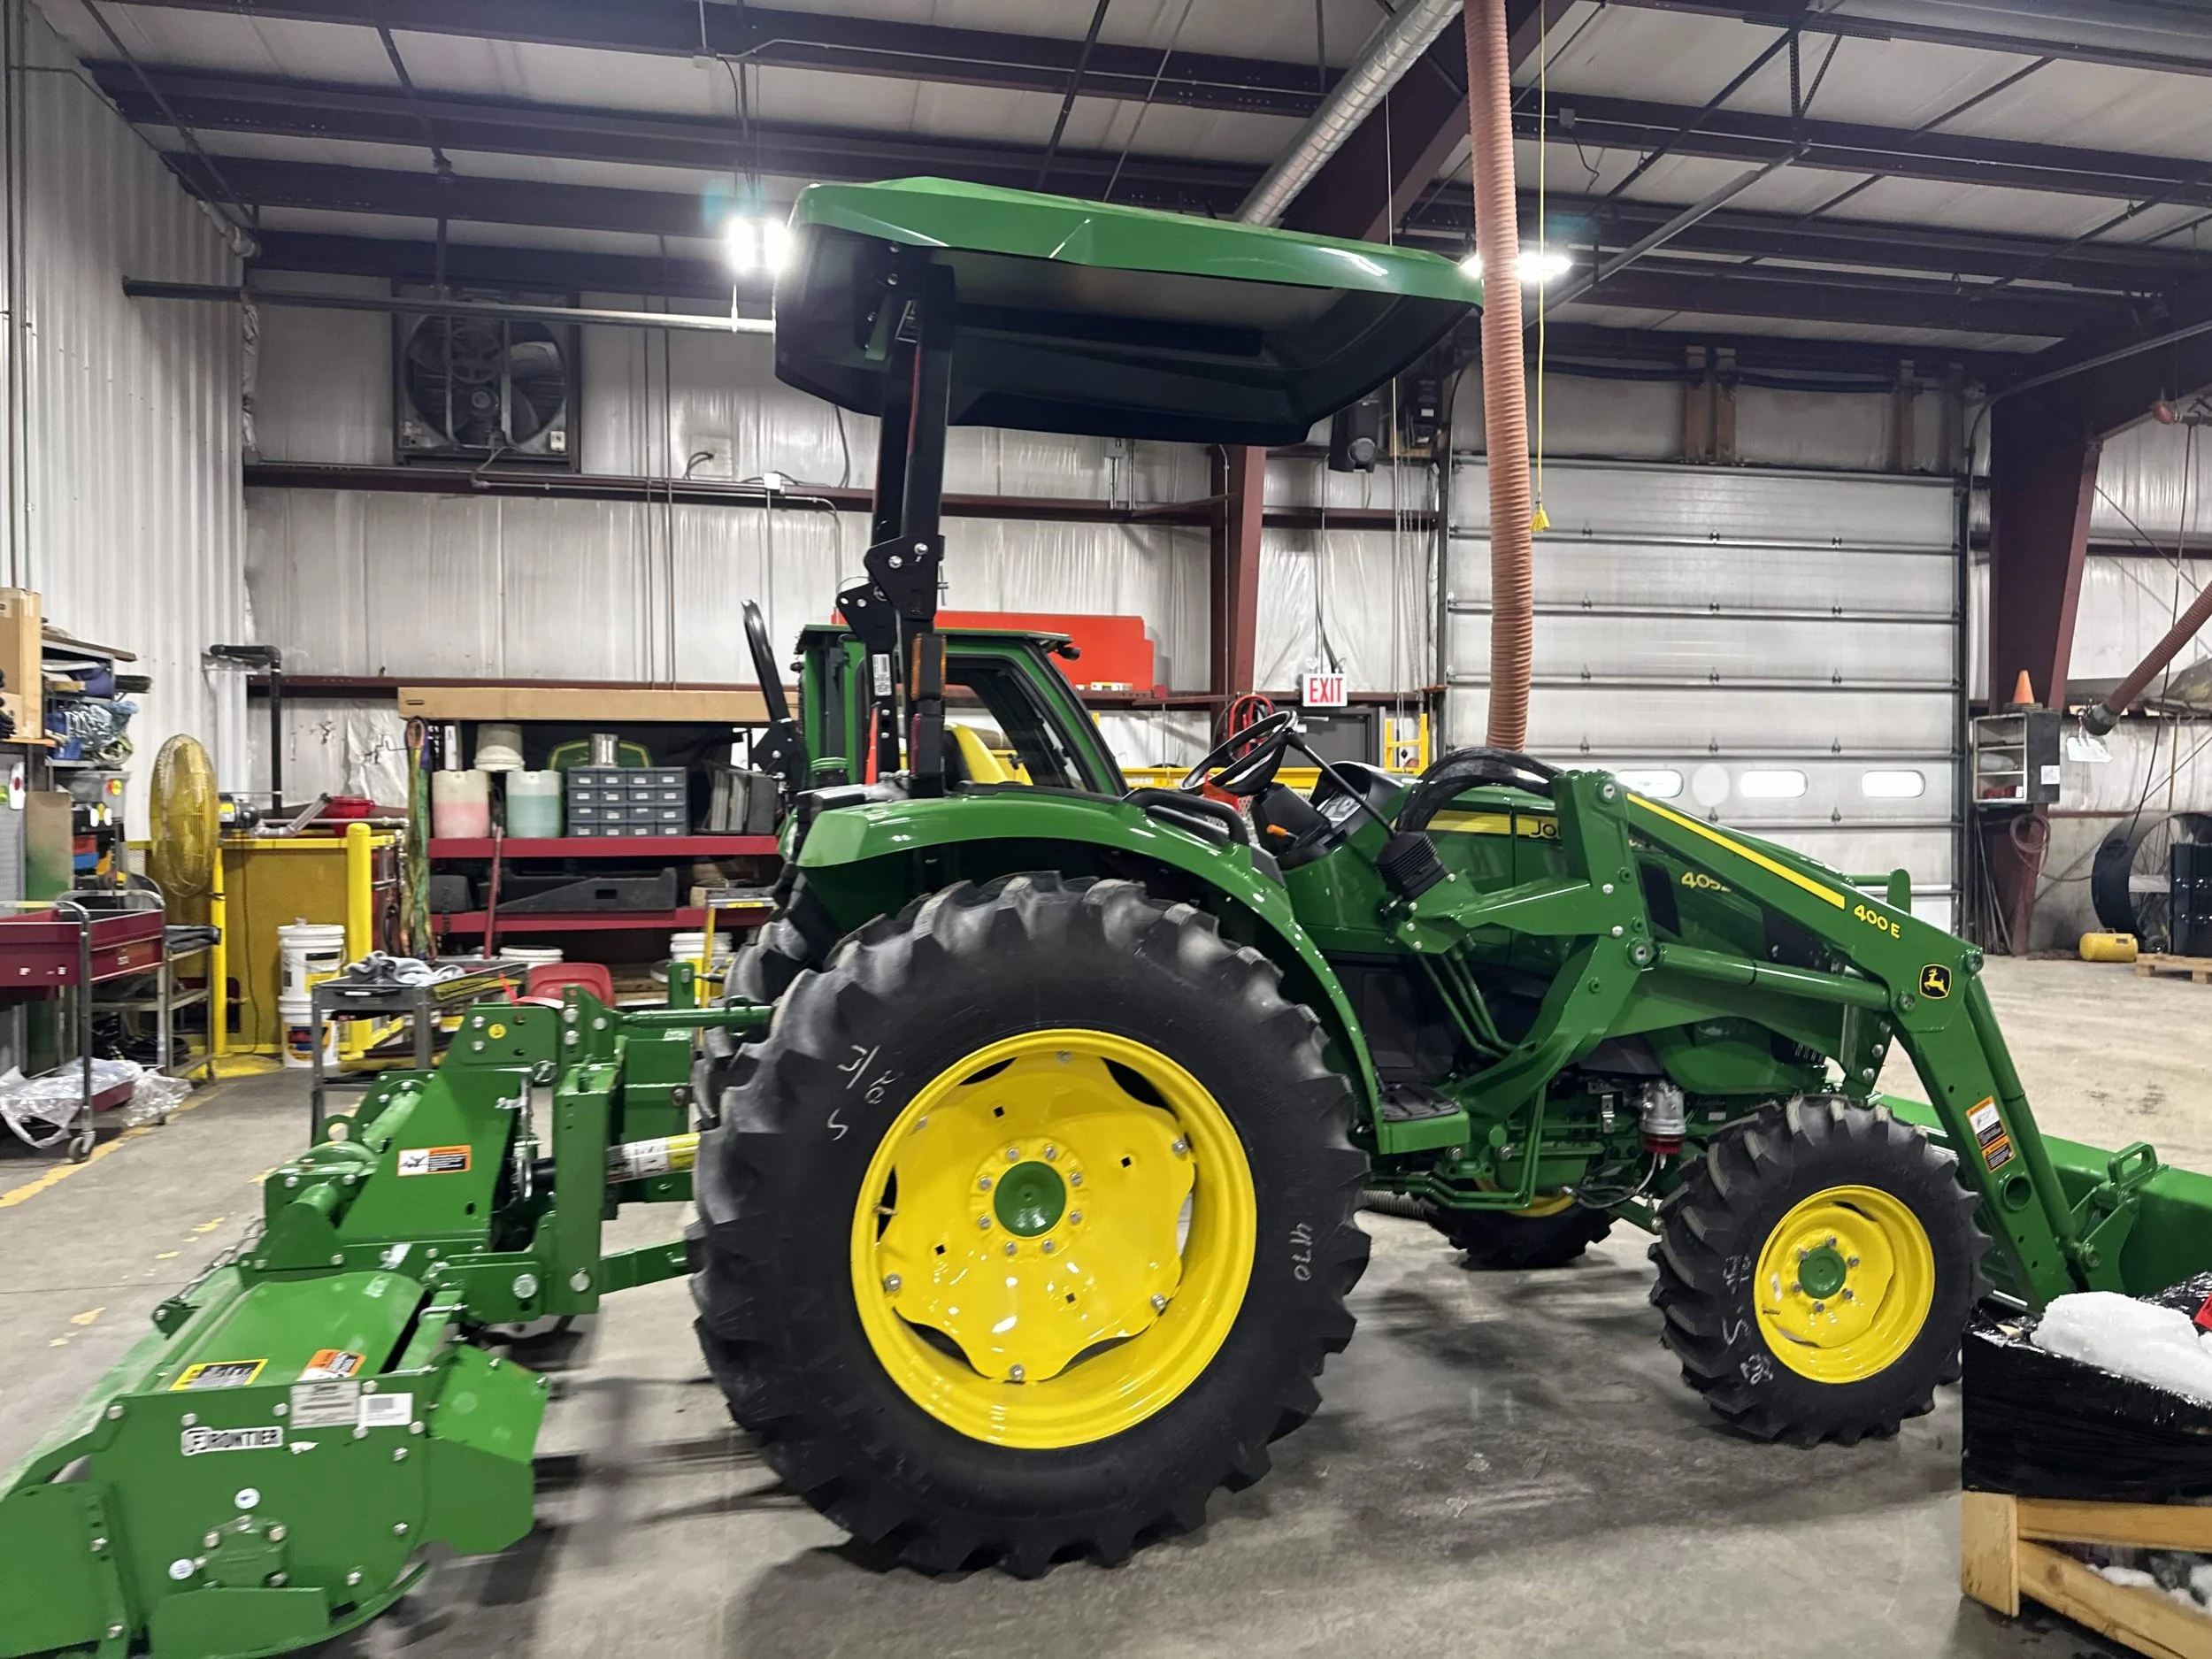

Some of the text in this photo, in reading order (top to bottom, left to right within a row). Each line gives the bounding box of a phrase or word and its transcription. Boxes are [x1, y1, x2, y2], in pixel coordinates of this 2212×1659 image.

[1309, 677, 1343, 703] EXIT
[1853, 903, 1901, 940] 400 E
